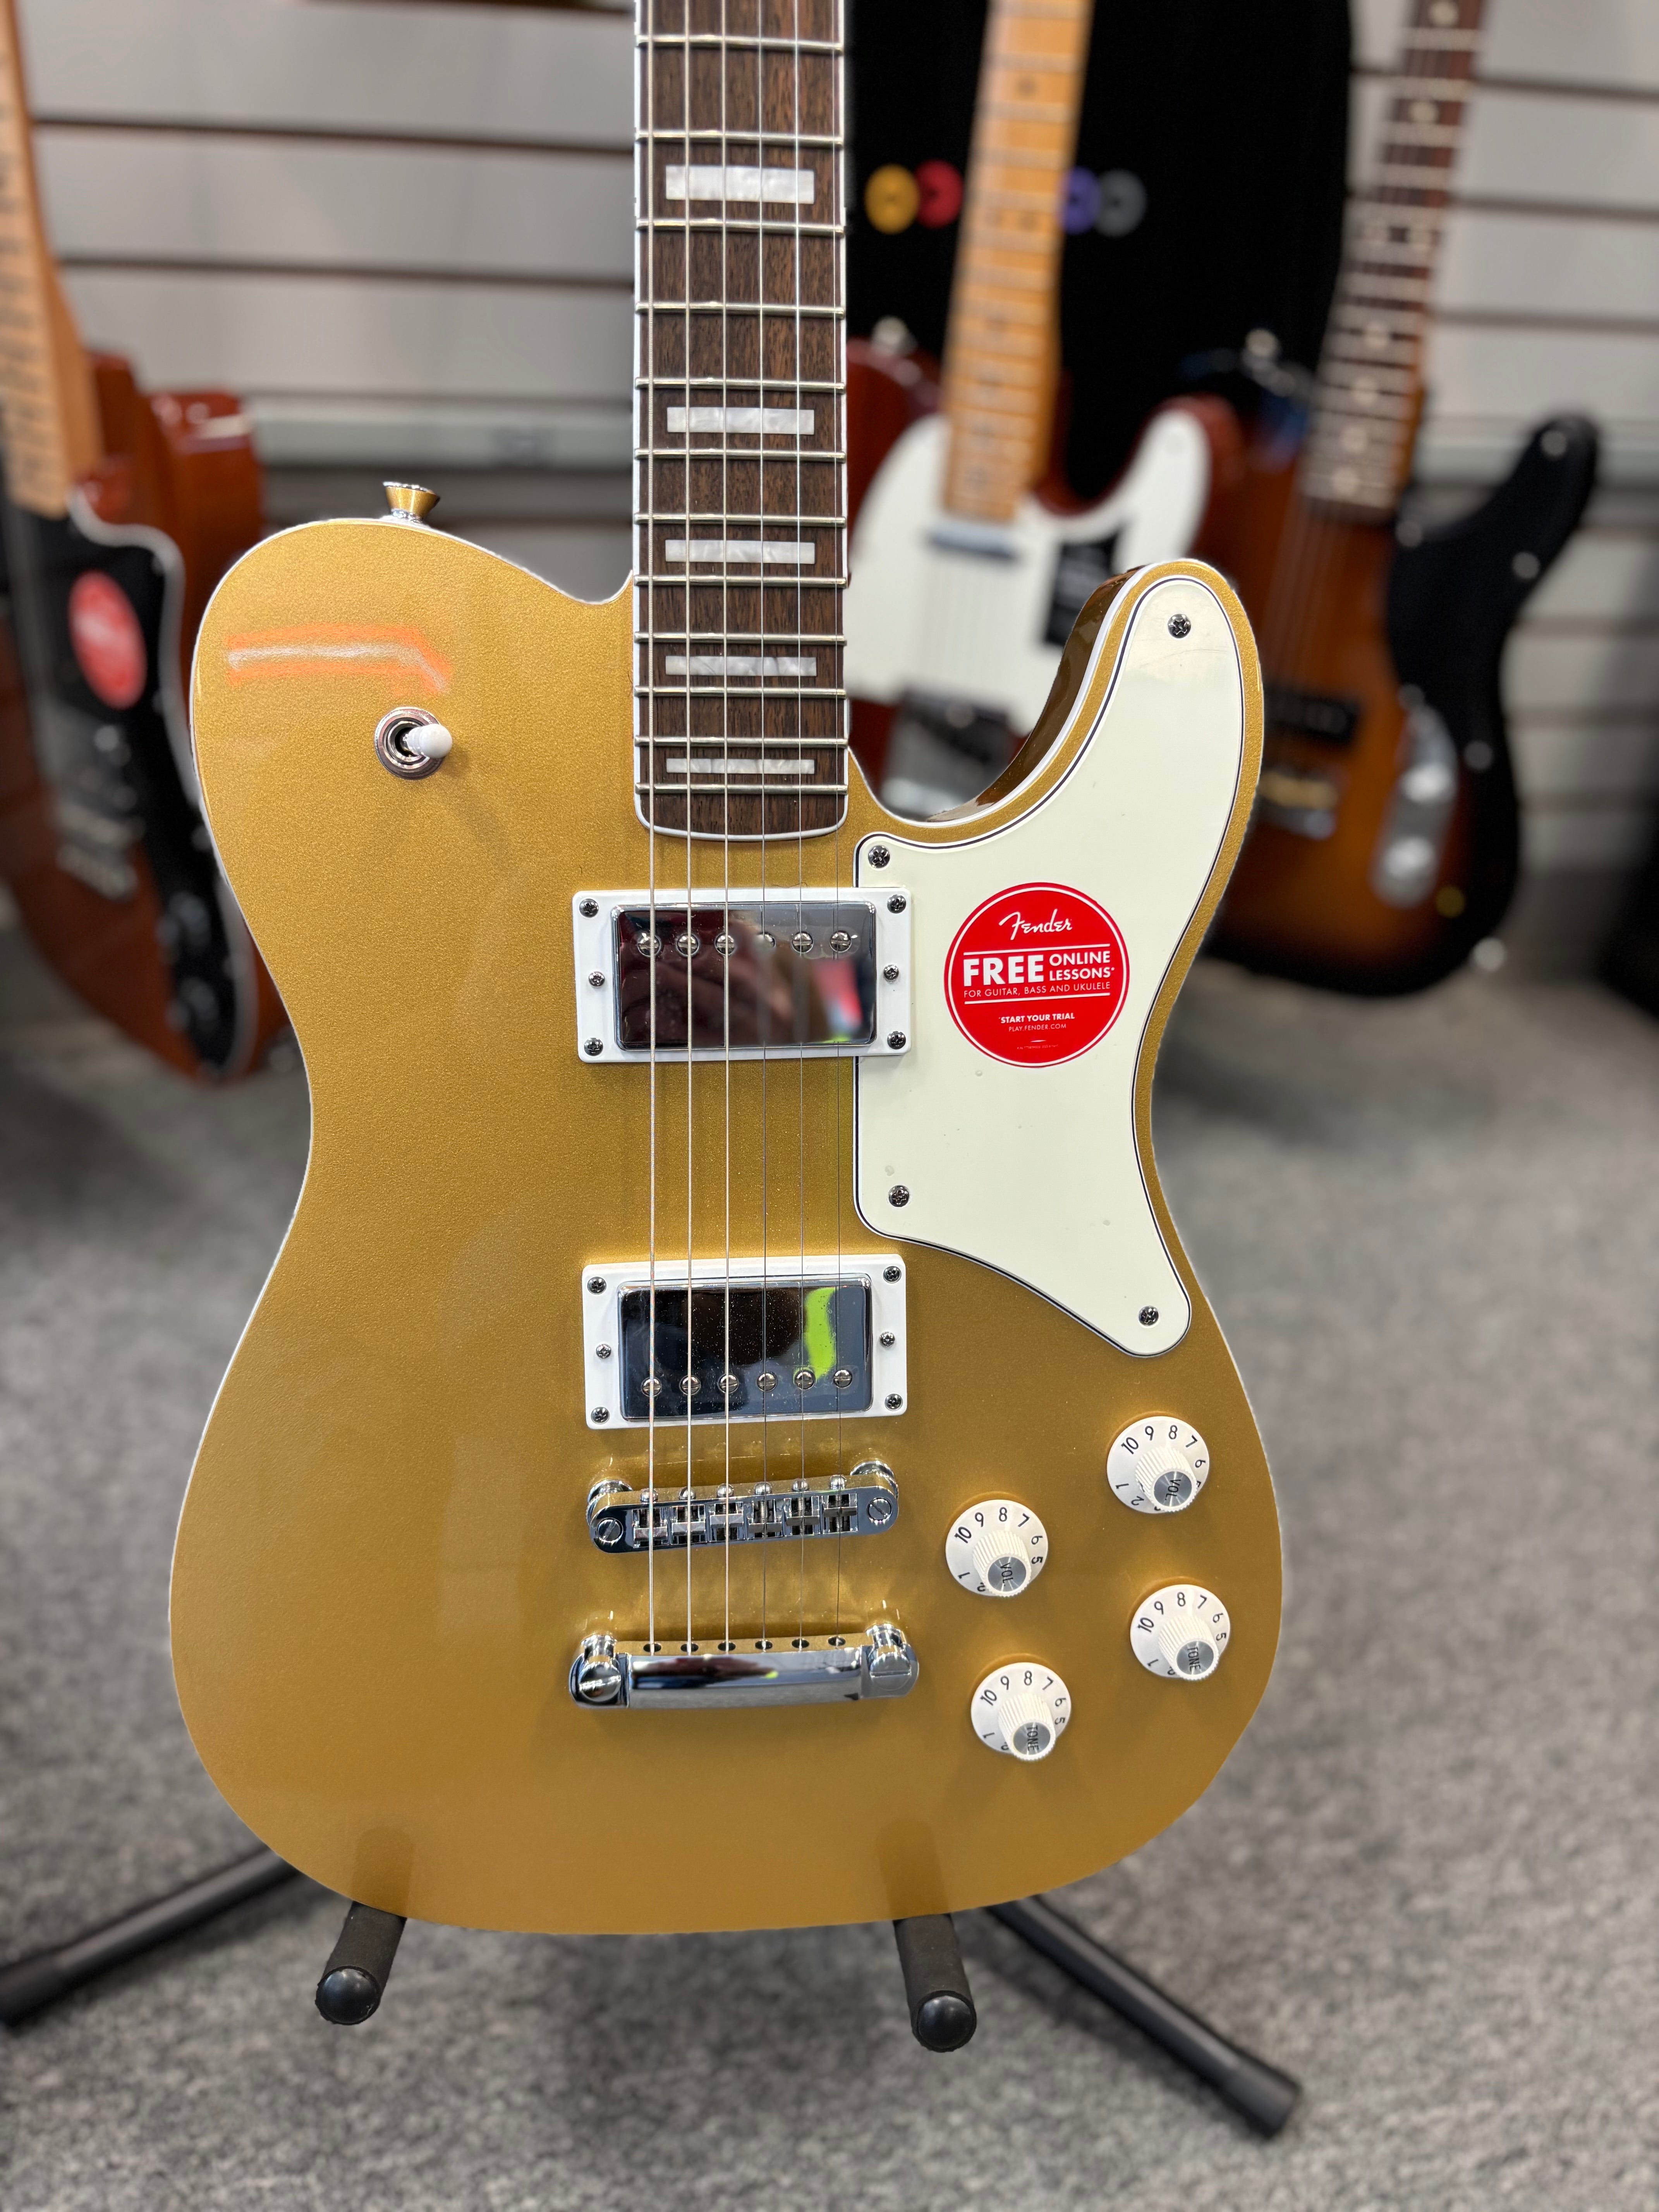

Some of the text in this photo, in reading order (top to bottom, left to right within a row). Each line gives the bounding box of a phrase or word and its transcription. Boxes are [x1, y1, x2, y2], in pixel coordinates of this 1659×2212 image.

[999, 908, 1072, 940] Fender
[1049, 951, 1110, 966] ONLINE
[963, 955, 1044, 987] FREE
[964, 981, 1110, 998] FOR GUITAR, BASS AND UKULELE
[1027, 1014, 1050, 1022] YOUR
[1052, 1012, 1075, 1020] TRIAL
[1008, 1023, 1066, 1032] PLAY.FENDER.COM
[1145, 1426, 1154, 1441] 9
[1169, 1425, 1177, 1439] 8
[1121, 1437, 1139, 1454] 10
[1186, 1434, 1198, 1448] 7
[1195, 1460, 1206, 1468] 6
[1131, 1496, 1144, 1505] 2
[954, 1527, 972, 1543] 10
[975, 1512, 984, 1527] 9
[999, 1507, 1007, 1522] 8
[1018, 1513, 1030, 1527] 7
[1031, 1535, 1043, 1545] 6
[1177, 1592, 1185, 1606] 8
[1198, 1595, 1207, 1609] 7
[1154, 1601, 1164, 1615] 9
[1137, 1617, 1154, 1633] 10
[1213, 1613, 1223, 1623] 6
[1216, 1632, 1226, 1641] 5
[1187, 1646, 1200, 1672] TONE
[980, 1689, 997, 1706] 10
[1001, 1676, 1009, 1690] 9
[1024, 1670, 1032, 1685] 8
[1042, 1676, 1054, 1690] 7
[1055, 1698, 1066, 1707] 6
[1027, 1725, 1039, 1751] TONE
